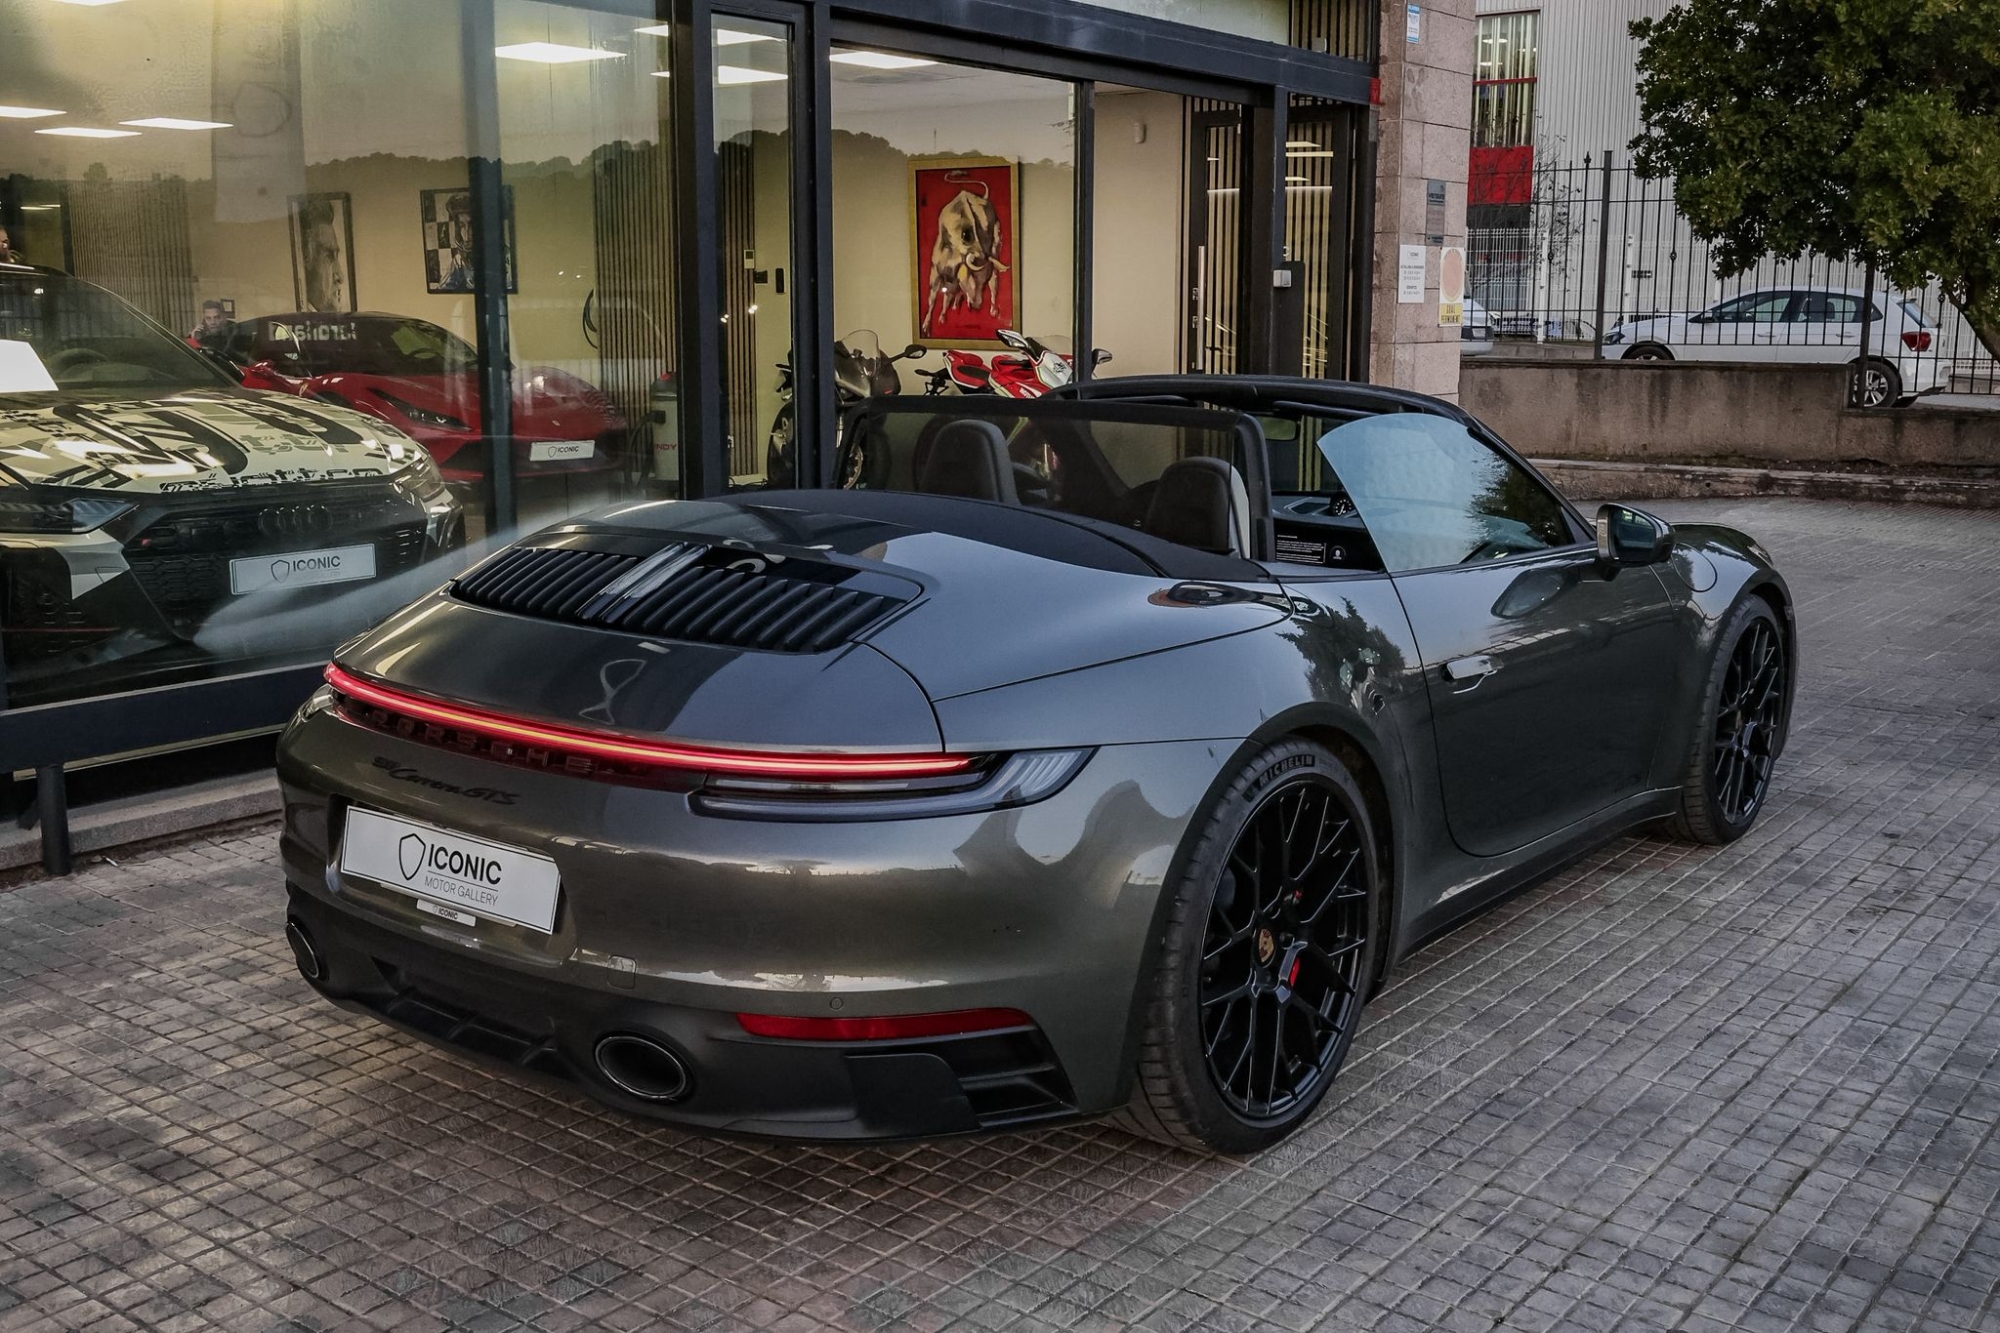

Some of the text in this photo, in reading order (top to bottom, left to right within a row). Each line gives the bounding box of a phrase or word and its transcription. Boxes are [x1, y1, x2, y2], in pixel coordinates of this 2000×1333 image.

[557, 445, 579, 457] ICONIC
[293, 555, 341, 572] ICONIC
[373, 711, 591, 774] PORSCHE
[1260, 755, 1314, 787] MICHELIN
[462, 788, 522, 806] GTS
[428, 844, 502, 885] ICONIC
[425, 876, 499, 906] MOTOR GALLERY
[438, 908, 459, 920] ICONIC
